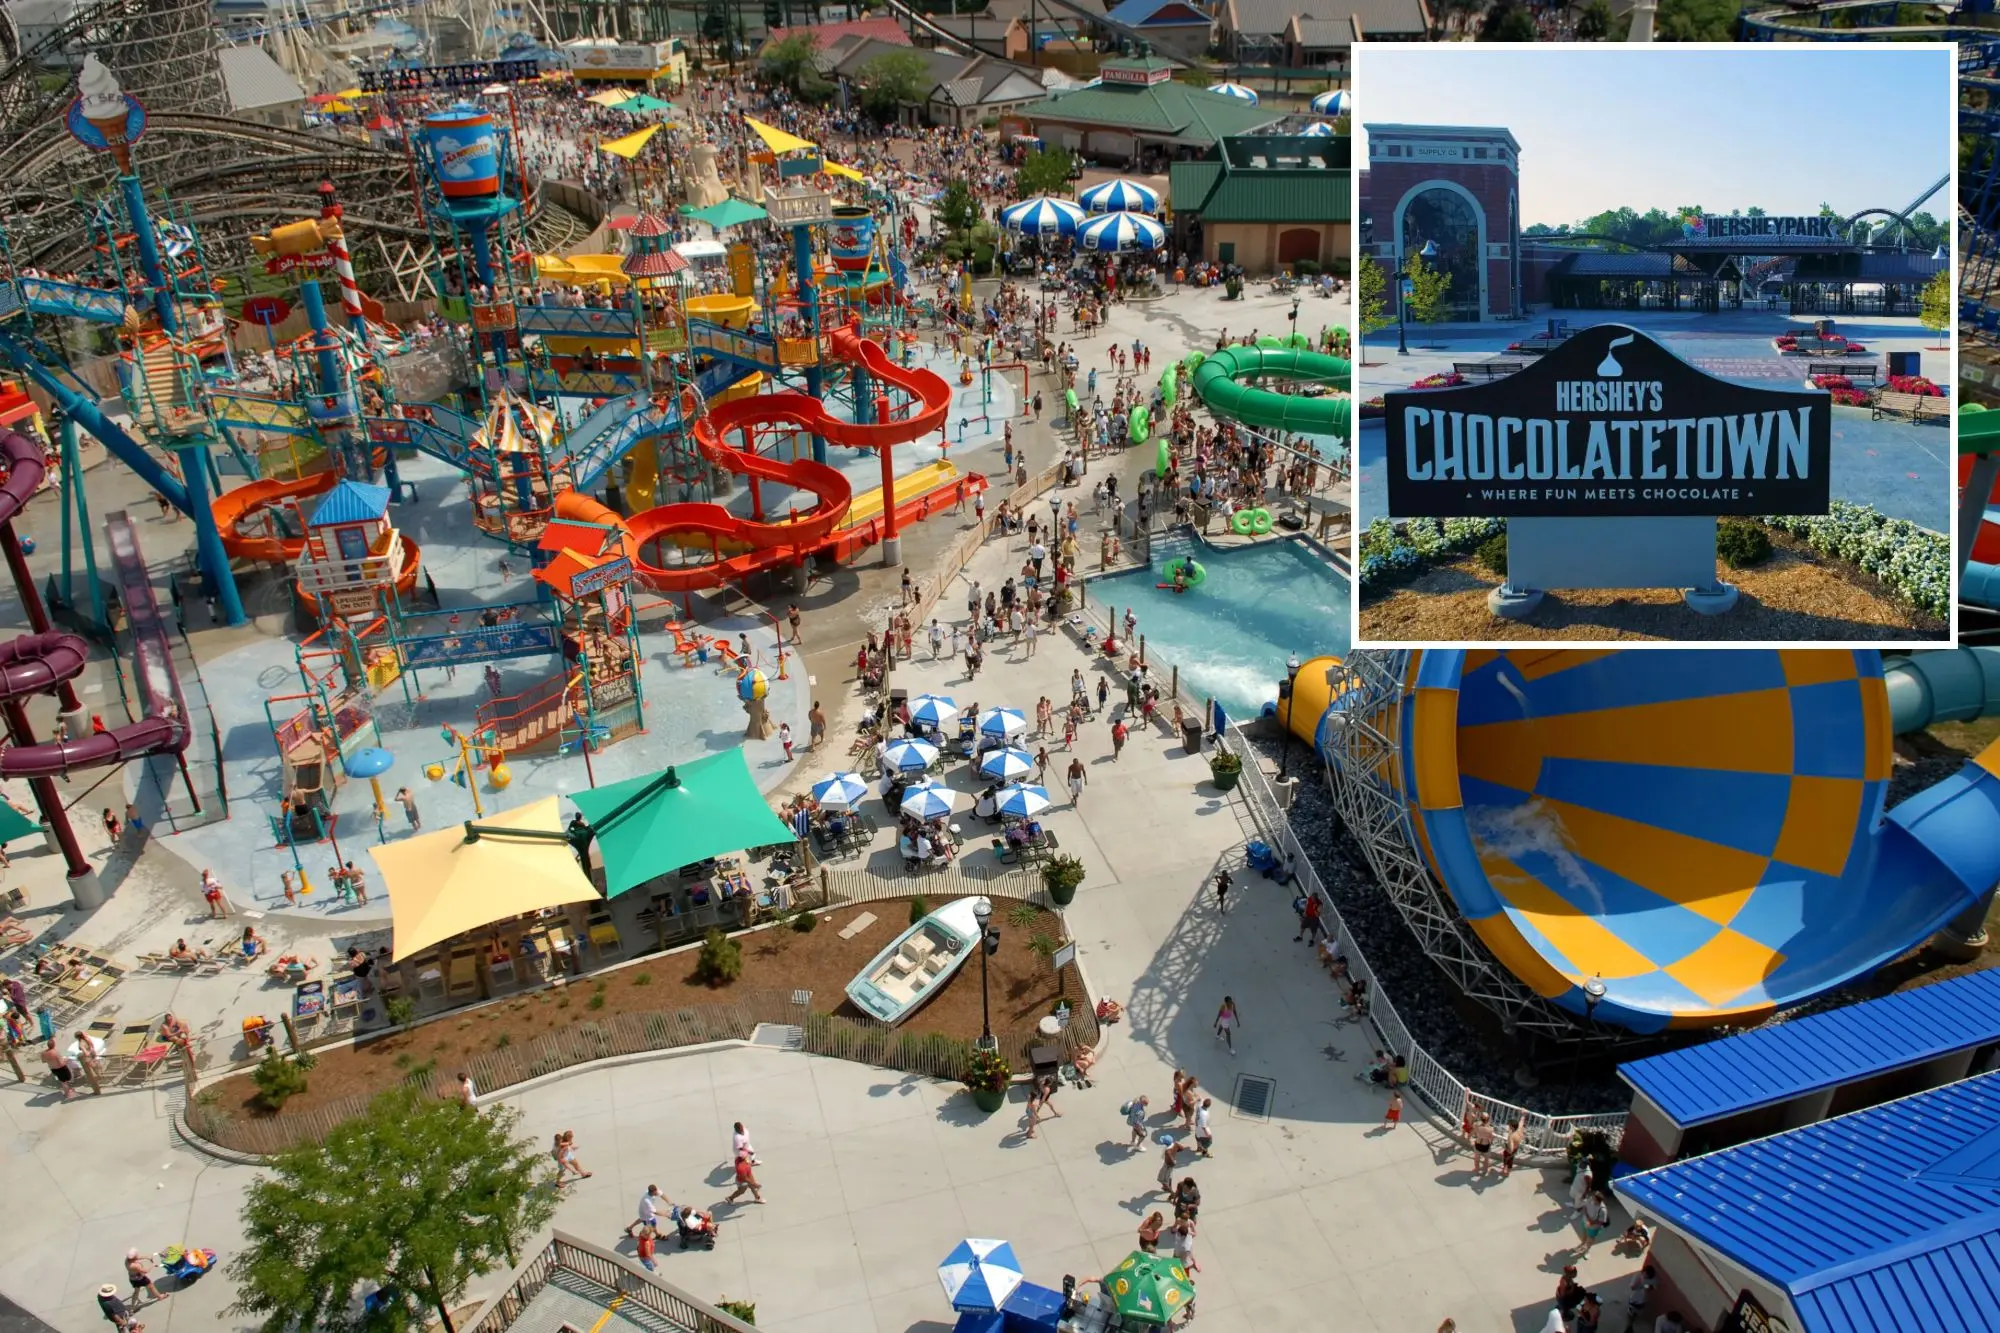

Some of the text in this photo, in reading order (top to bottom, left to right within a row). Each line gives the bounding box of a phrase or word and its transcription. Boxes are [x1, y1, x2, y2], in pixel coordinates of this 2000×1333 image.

[1418, 148, 1445, 156] SUPPLY
[1706, 216, 1833, 238] HERSHEYPARK
[1556, 381, 1663, 412] HERSHEY'S
[1404, 405, 1812, 481] CHOCOLATETOWN
[1481, 488, 1740, 500] WHERE FUN MEETS CHOCOLATE
[335, 595, 373, 604] LIFEGUARD
